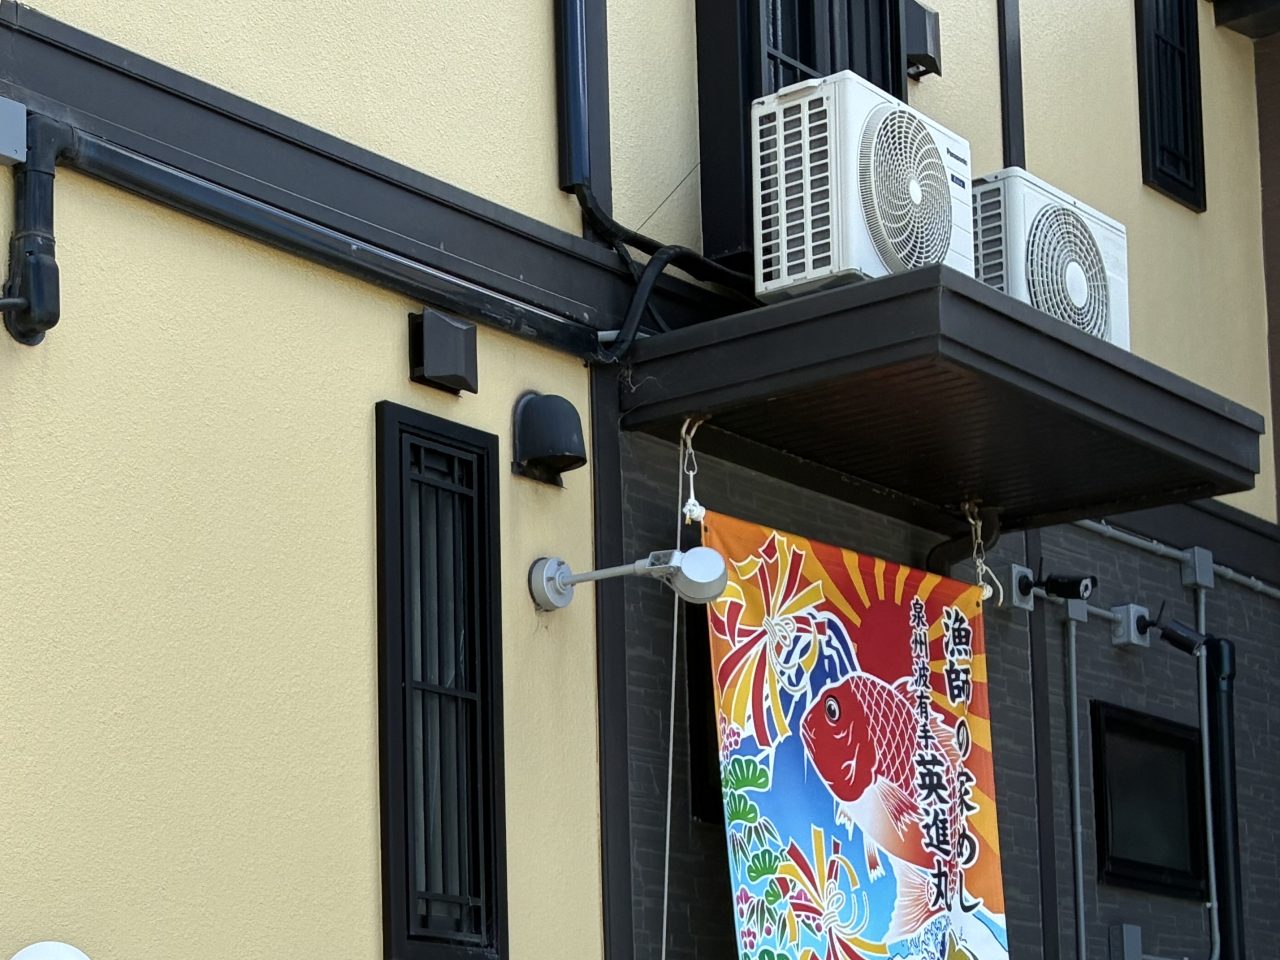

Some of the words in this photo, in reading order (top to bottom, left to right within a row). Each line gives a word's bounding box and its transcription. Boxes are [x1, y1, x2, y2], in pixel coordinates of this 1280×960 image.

[942, 606, 984, 913] 漁師の家めし
